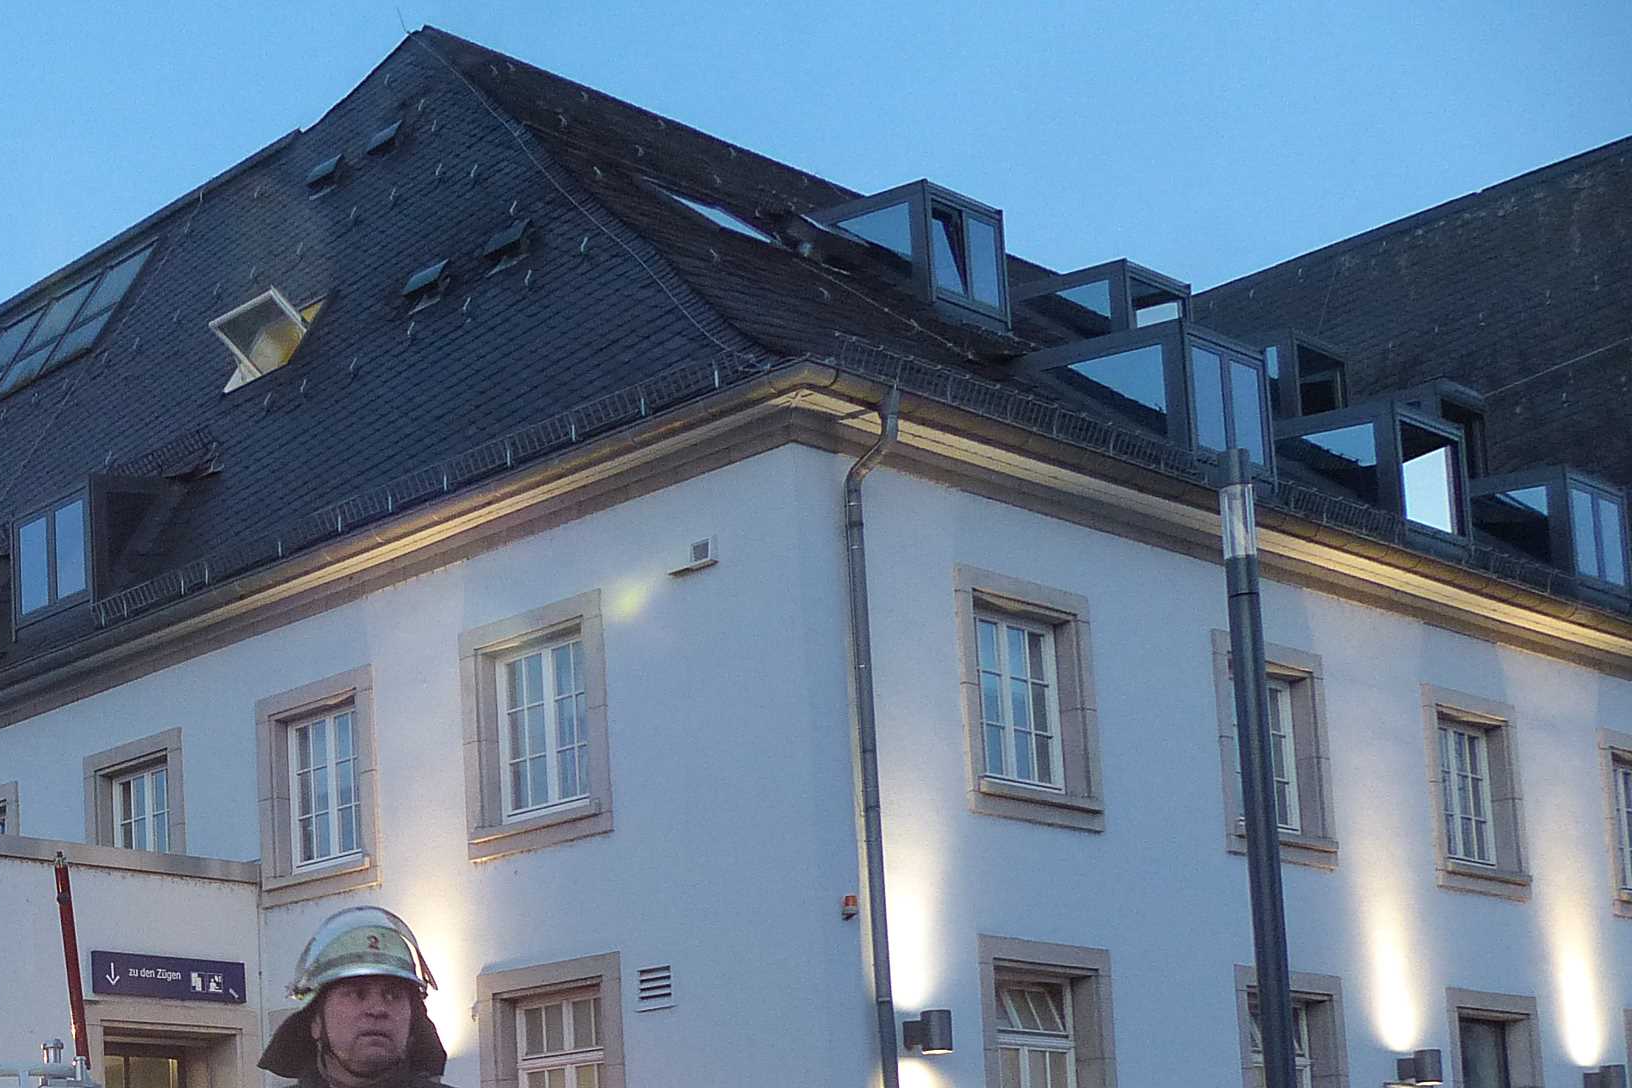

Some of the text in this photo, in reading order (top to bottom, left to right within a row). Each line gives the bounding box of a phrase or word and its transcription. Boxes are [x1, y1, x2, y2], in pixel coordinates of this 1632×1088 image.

[367, 935, 380, 950] 2
[128, 967, 182, 981] zu den Zügen
